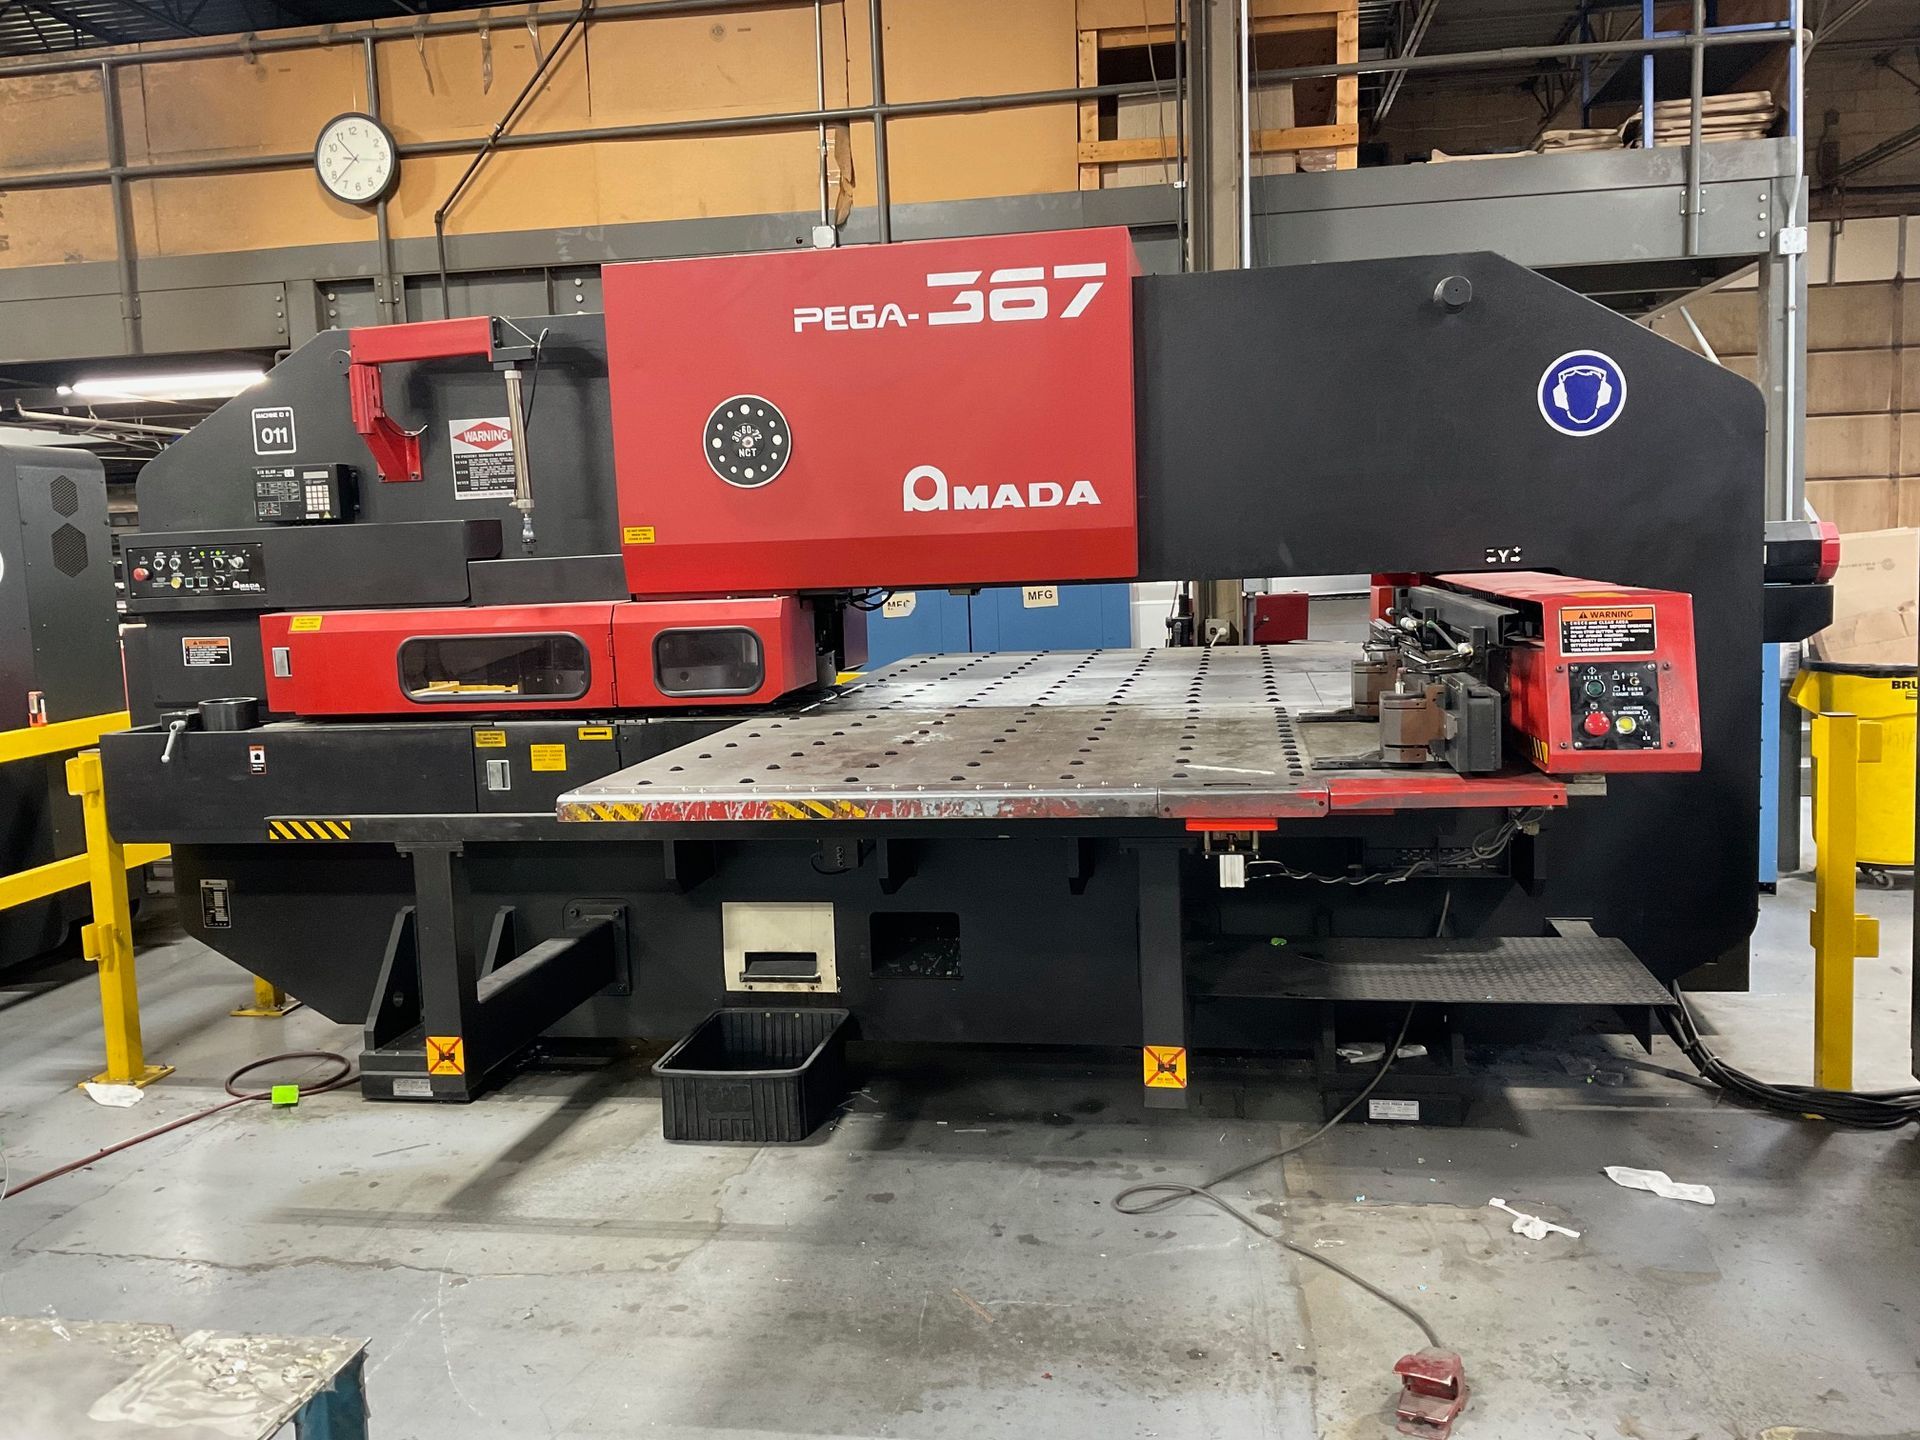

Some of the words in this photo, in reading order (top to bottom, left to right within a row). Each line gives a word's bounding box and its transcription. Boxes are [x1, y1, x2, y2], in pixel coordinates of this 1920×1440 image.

[348, 126, 357, 135] 12
[364, 130, 369, 138] 1
[336, 132, 344, 140] 11
[373, 138, 379, 148] 2
[329, 144, 338, 152] 10
[379, 152, 385, 160] 3
[326, 158, 332, 166] 9
[331, 171, 337, 179] 8
[343, 181, 348, 189] 7
[368, 177, 373, 186] 5
[355, 182, 361, 191] 6
[794, 262, 1106, 332] PEGA-367
[262, 427, 288, 444] 011
[464, 430, 508, 442] WARNING
[739, 448, 756, 457] NCT
[903, 465, 1101, 512] AMADA
[1498, 550, 1509, 563] Y
[1028, 590, 1052, 600] MFG
